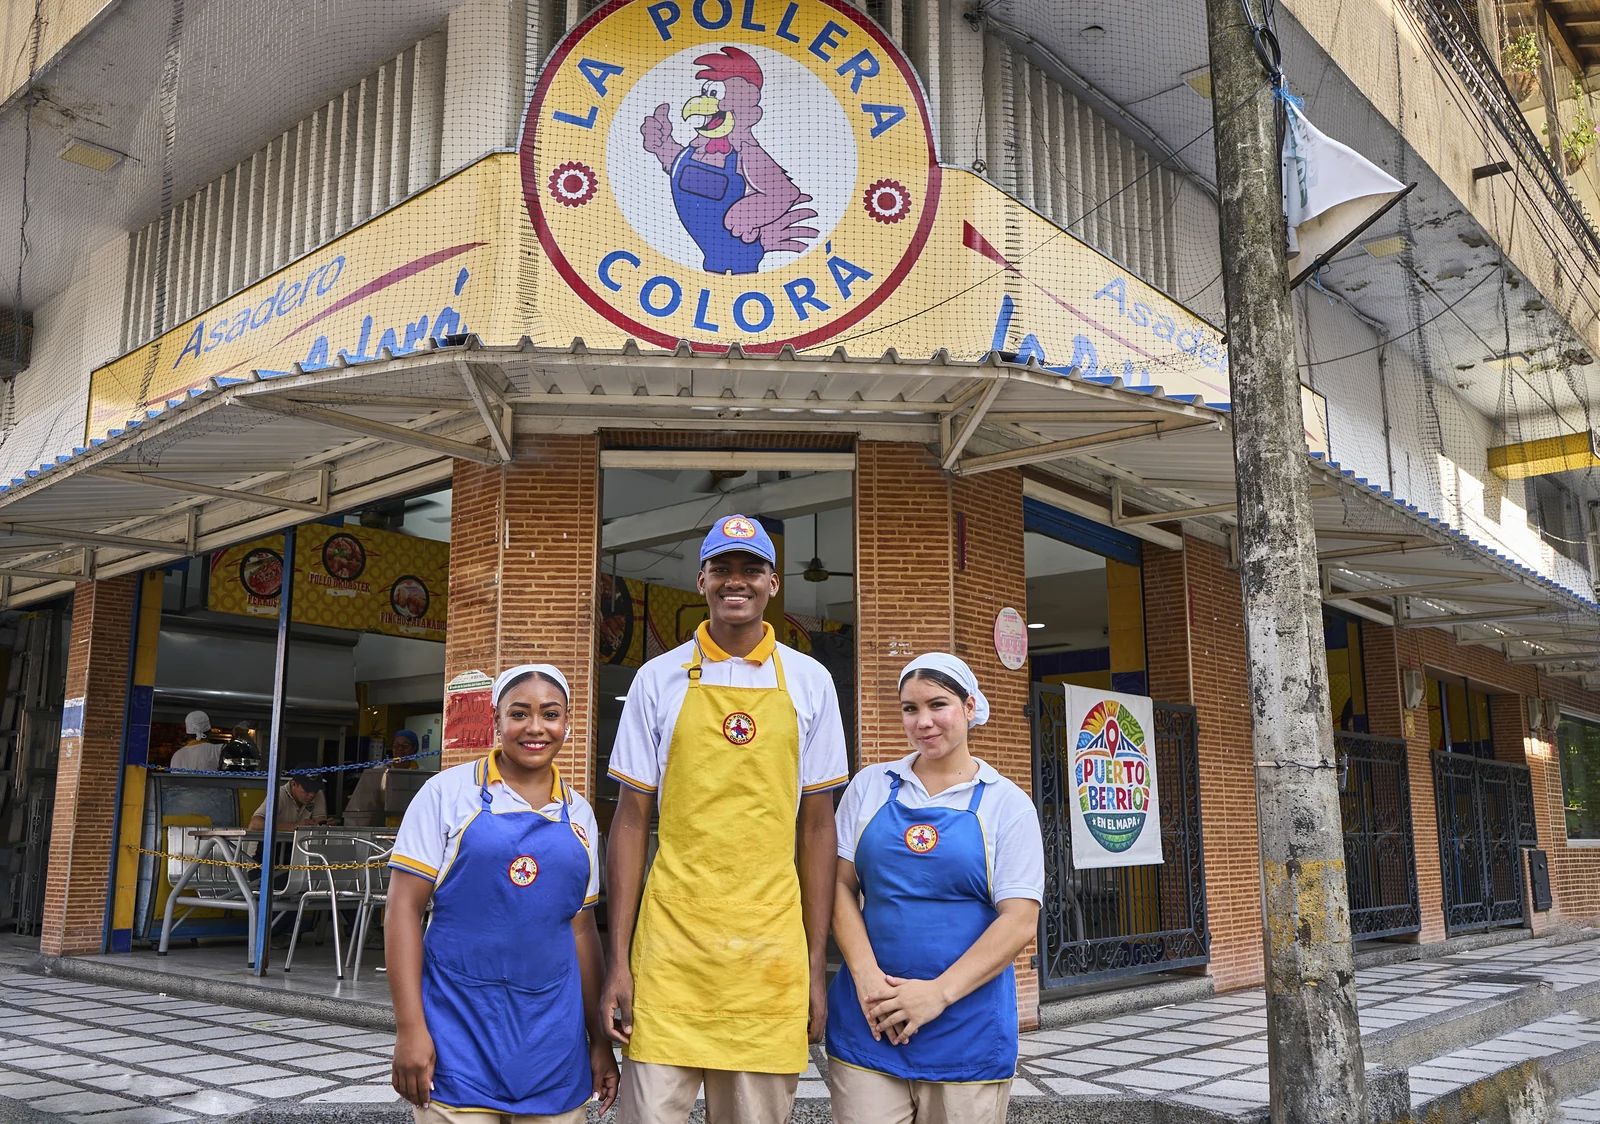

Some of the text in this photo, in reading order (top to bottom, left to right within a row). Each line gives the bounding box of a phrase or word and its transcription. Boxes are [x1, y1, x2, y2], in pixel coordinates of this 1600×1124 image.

[552, 0, 907, 139] LA POLLERA
[597, 240, 873, 333] COLORÁ
[173, 255, 346, 370] Asadero
[1093, 277, 1228, 373] Asade
[308, 571, 331, 586] POLLO
[379, 612, 409, 627] PINCHOS
[1084, 759, 1144, 785] PUERTO
[1088, 784, 1143, 810] BERRÍO
[1097, 816, 1137, 830] EN EL MAPA
